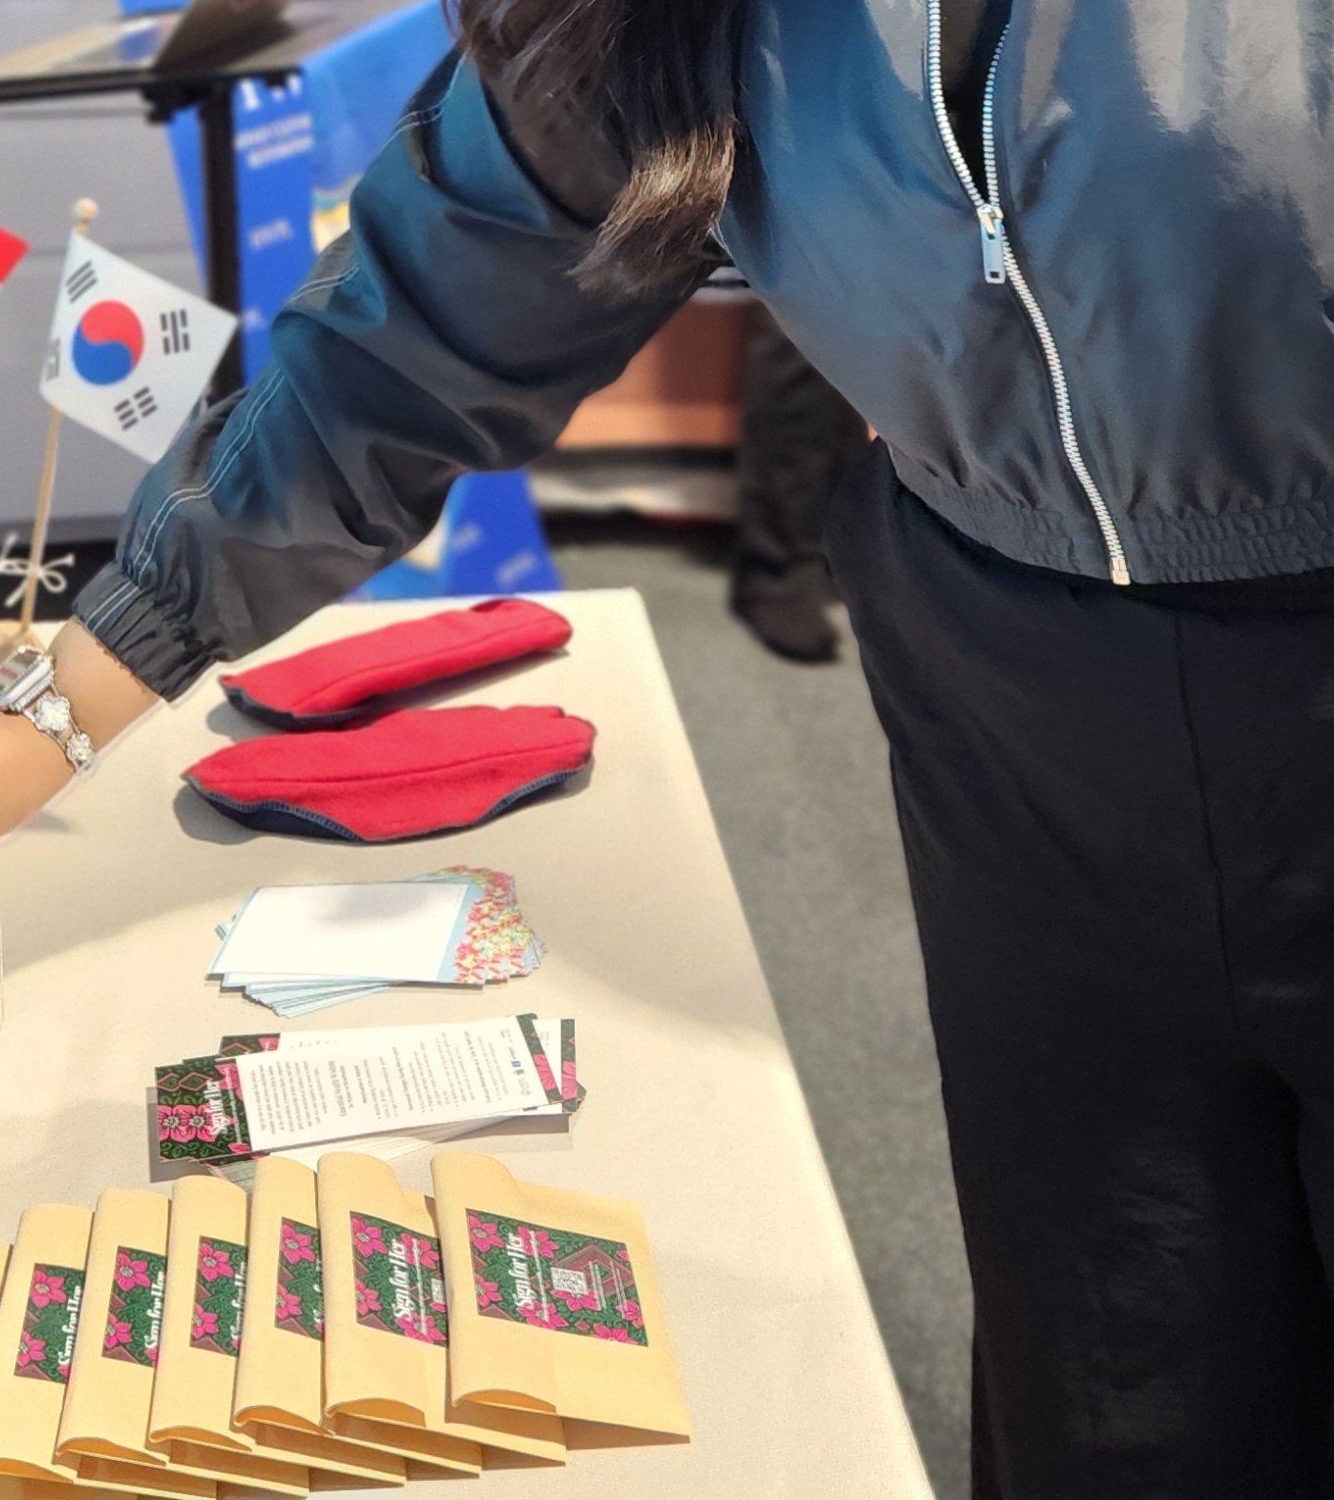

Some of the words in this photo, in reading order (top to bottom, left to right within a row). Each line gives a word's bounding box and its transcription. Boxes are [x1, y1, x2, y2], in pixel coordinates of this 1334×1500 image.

[388, 1238, 406, 1267] Her
[505, 1232, 525, 1261] Her
[389, 1267, 409, 1290] for
[508, 1259, 530, 1280] for
[392, 1289, 415, 1321] Sign
[513, 1279, 536, 1309] Sign
